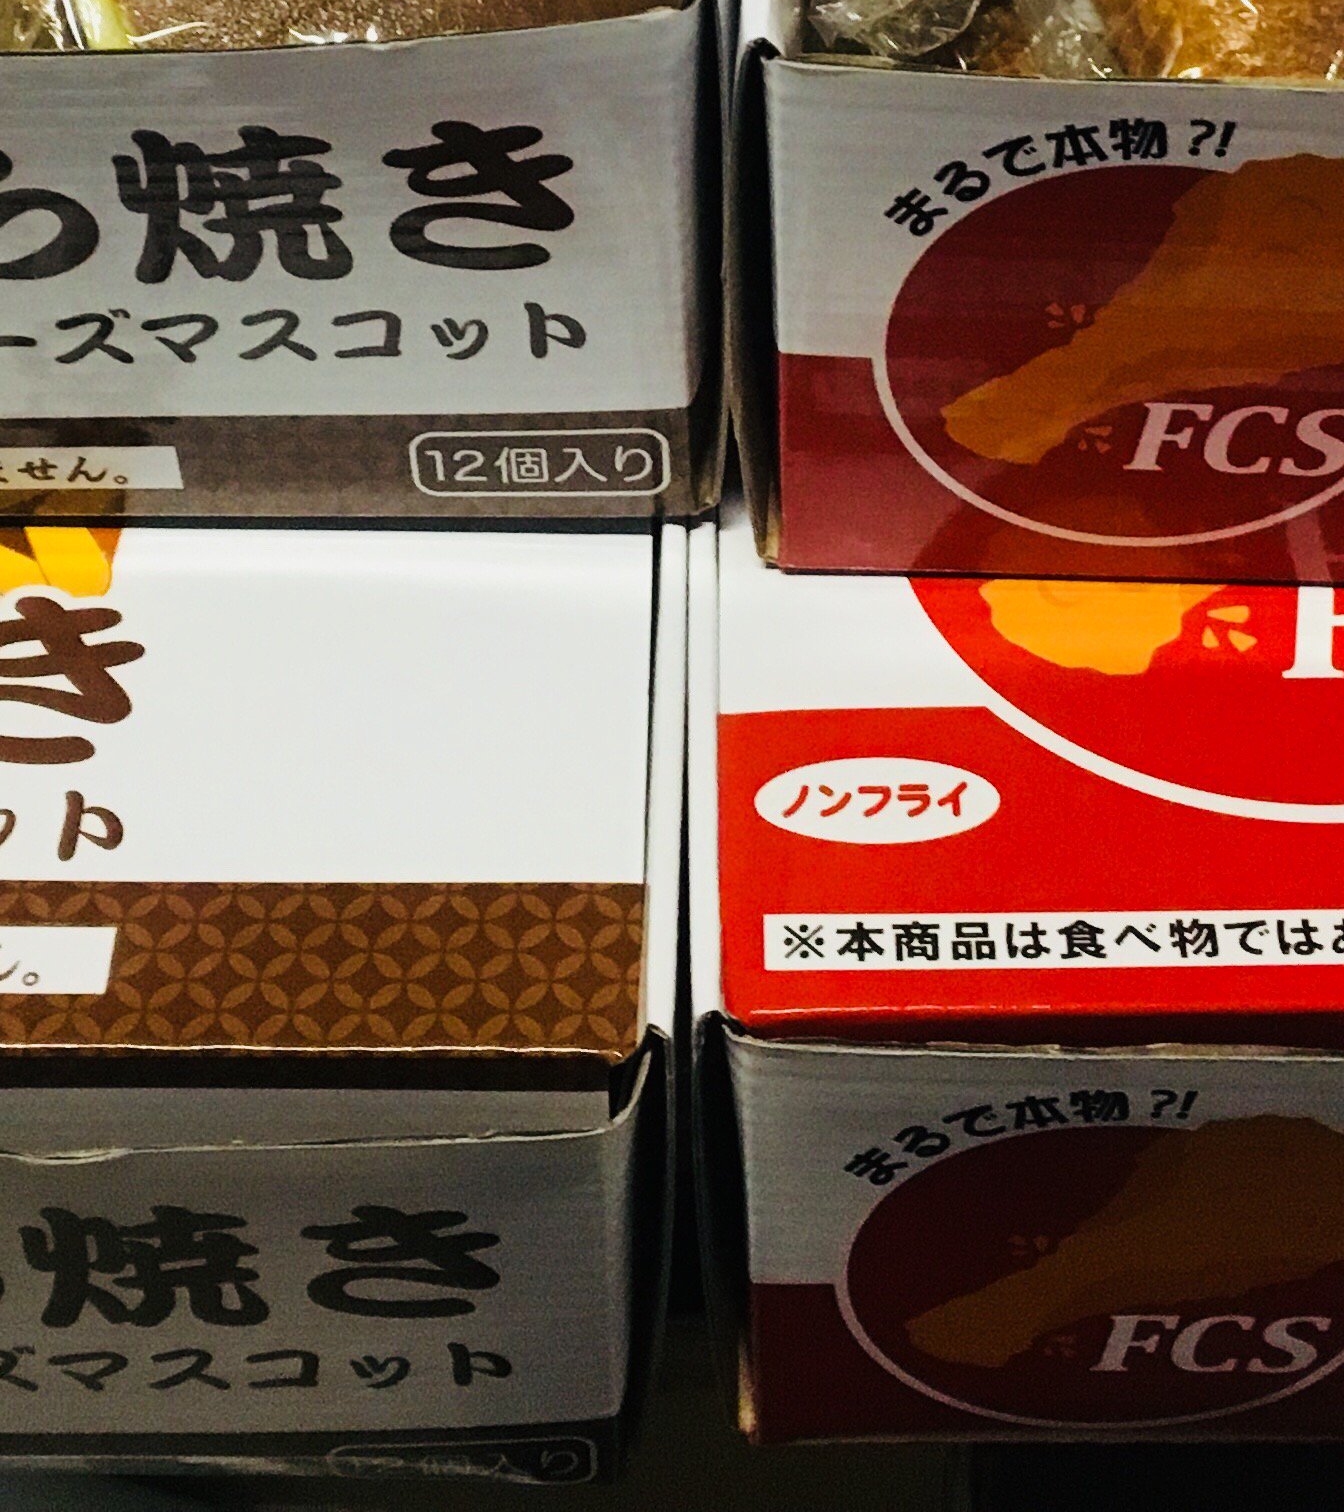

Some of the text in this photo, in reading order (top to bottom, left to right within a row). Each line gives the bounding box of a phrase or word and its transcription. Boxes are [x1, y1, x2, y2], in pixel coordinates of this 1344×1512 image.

[884, 118, 1237, 236] まるで本物?!
[422, 443, 654, 486] 12個入り
[781, 781, 967, 819] ノンフライ
[843, 1088, 1199, 1187] まるで本物?!
[1089, 1314, 1333, 1374] FCS
